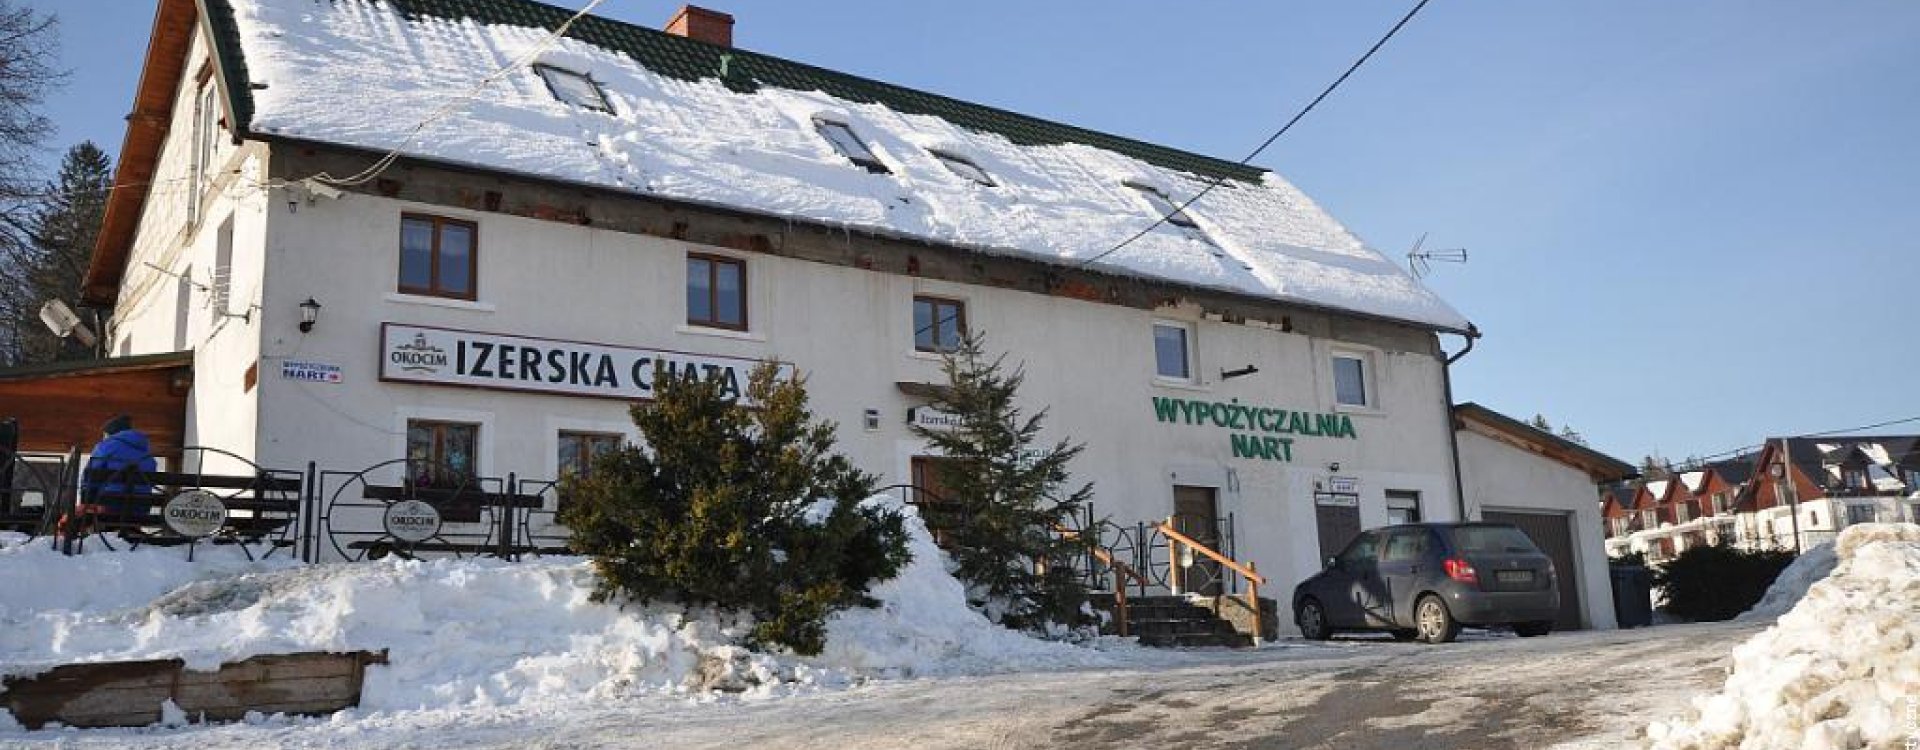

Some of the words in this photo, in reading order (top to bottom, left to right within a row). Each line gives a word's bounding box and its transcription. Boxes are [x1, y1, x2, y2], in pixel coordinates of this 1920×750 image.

[391, 350, 447, 366] OKOCIM
[456, 340, 618, 388] IZERSKA
[283, 369, 327, 380] NART
[1152, 396, 1357, 439] WYPOŻYCZALNIA
[1230, 433, 1294, 462] NART
[170, 508, 220, 521] OKOCIM
[391, 516, 434, 526] OKOCIM
